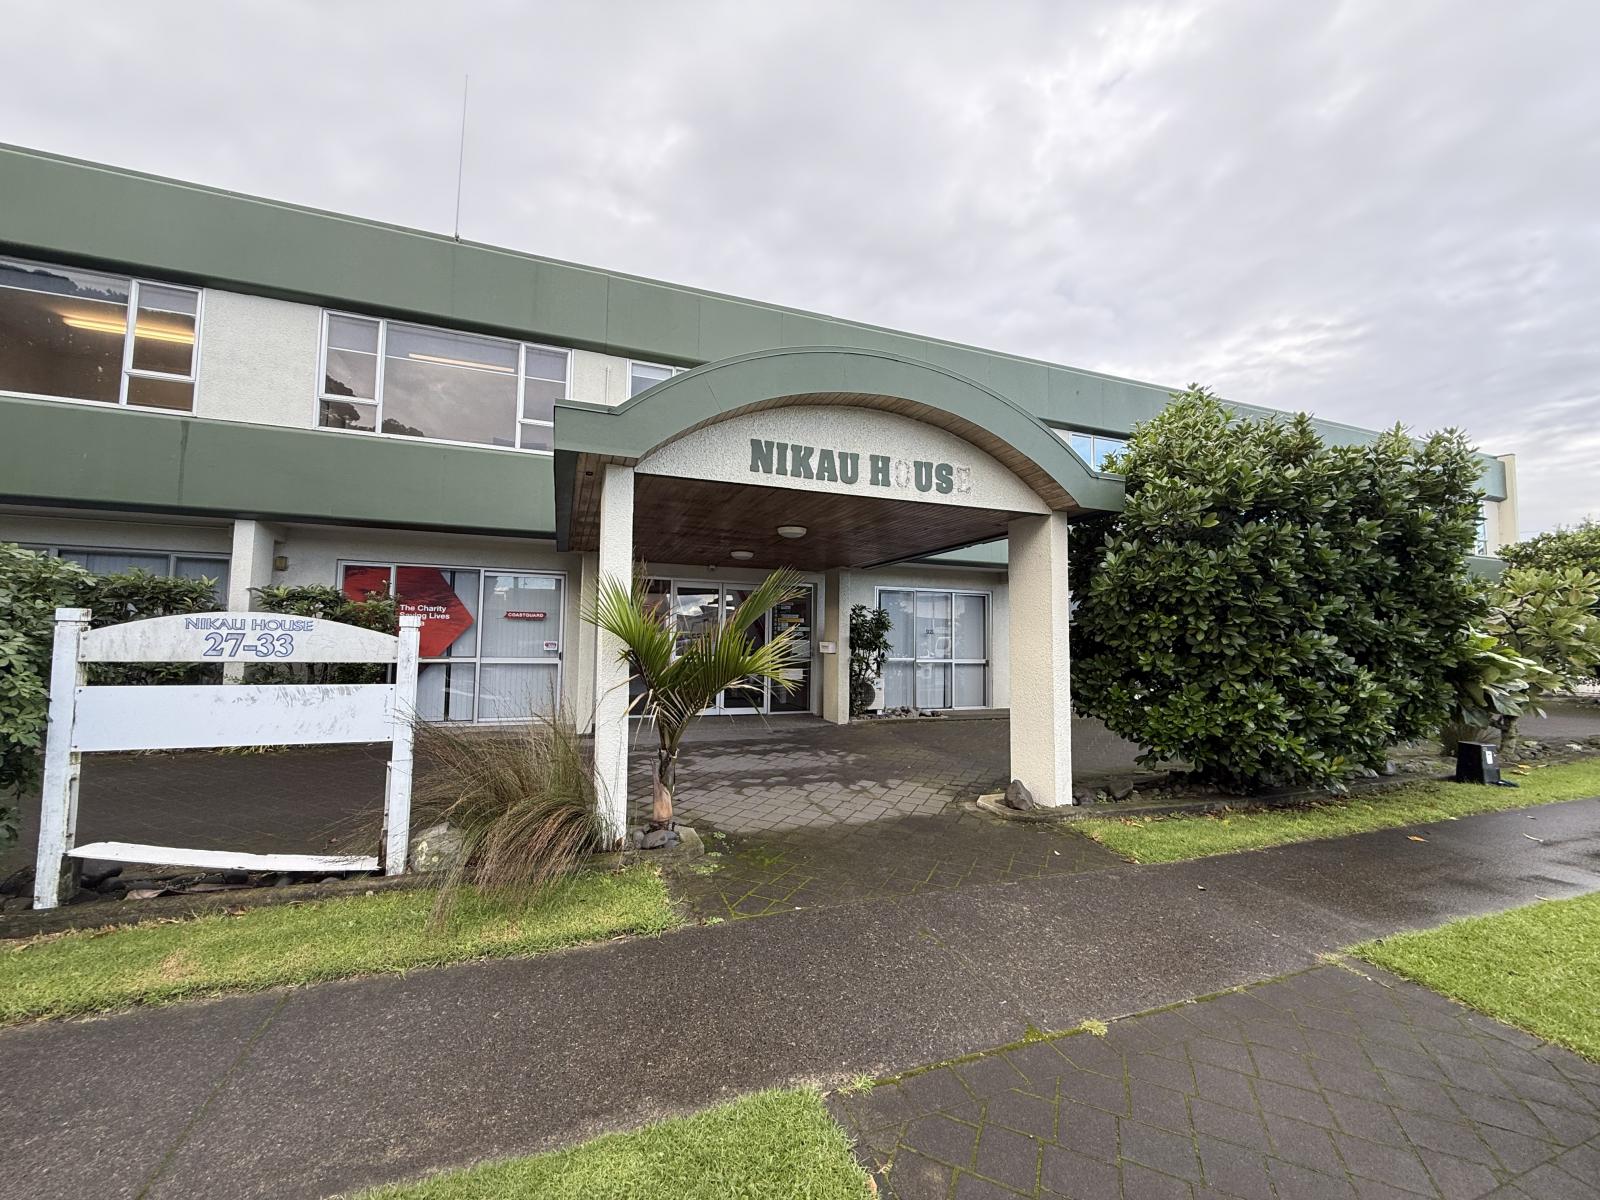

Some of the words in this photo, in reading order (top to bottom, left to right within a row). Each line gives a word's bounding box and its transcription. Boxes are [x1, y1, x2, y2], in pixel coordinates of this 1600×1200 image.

[750, 438, 860, 485] NIKAU
[417, 604, 447, 613] Charity
[429, 612, 450, 620] Lives
[185, 617, 246, 631] NIKAU
[251, 619, 314, 632] HOUSE
[202, 632, 294, 658] 27-33
